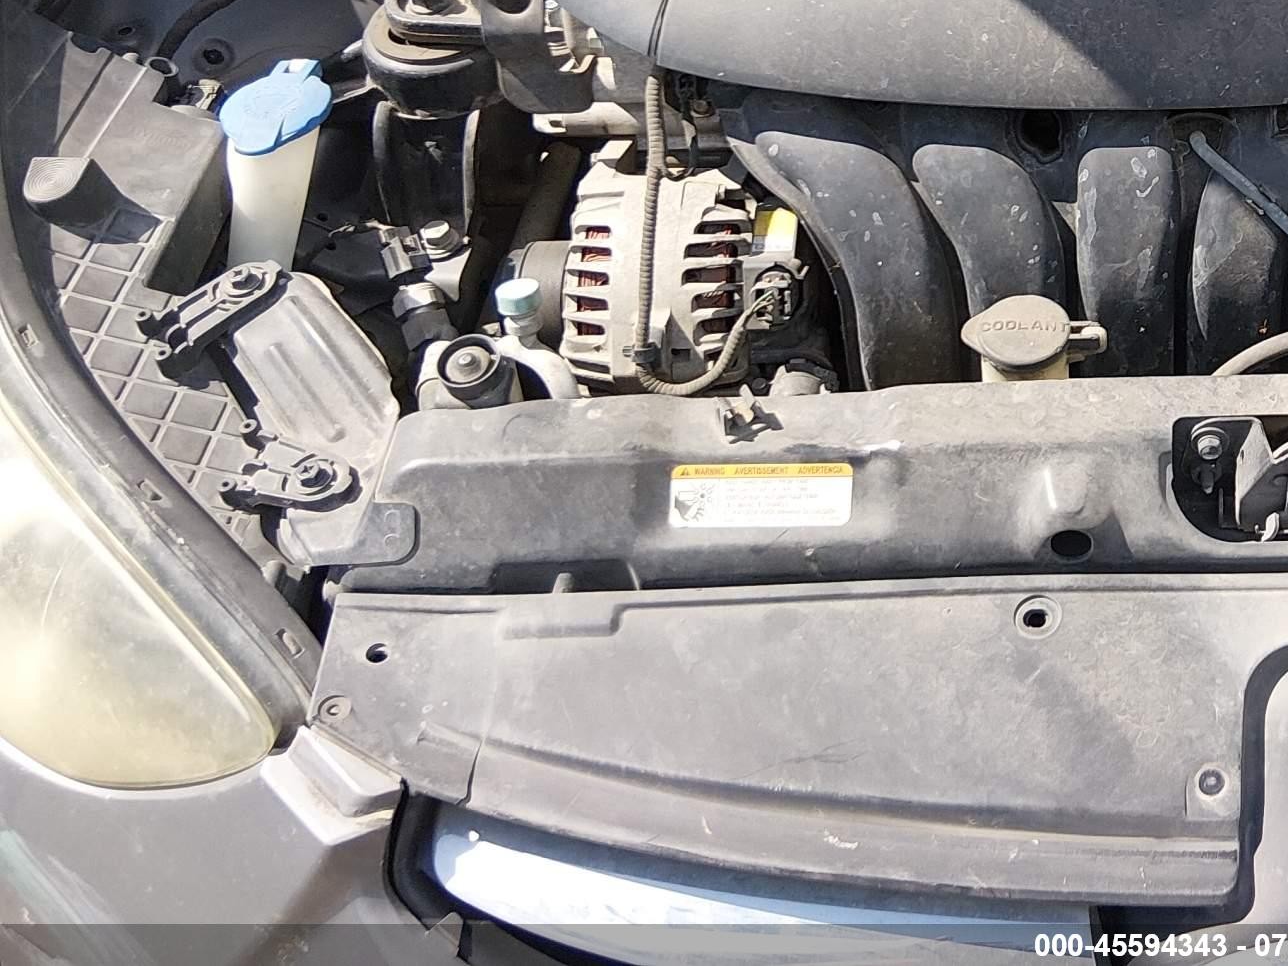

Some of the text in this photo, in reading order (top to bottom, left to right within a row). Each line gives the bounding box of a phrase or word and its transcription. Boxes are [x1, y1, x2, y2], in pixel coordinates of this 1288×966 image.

[980, 319, 1070, 333] COOLANT
[694, 465, 844, 475] WARNING AVERTISSEMENT ADVERTENCIA
